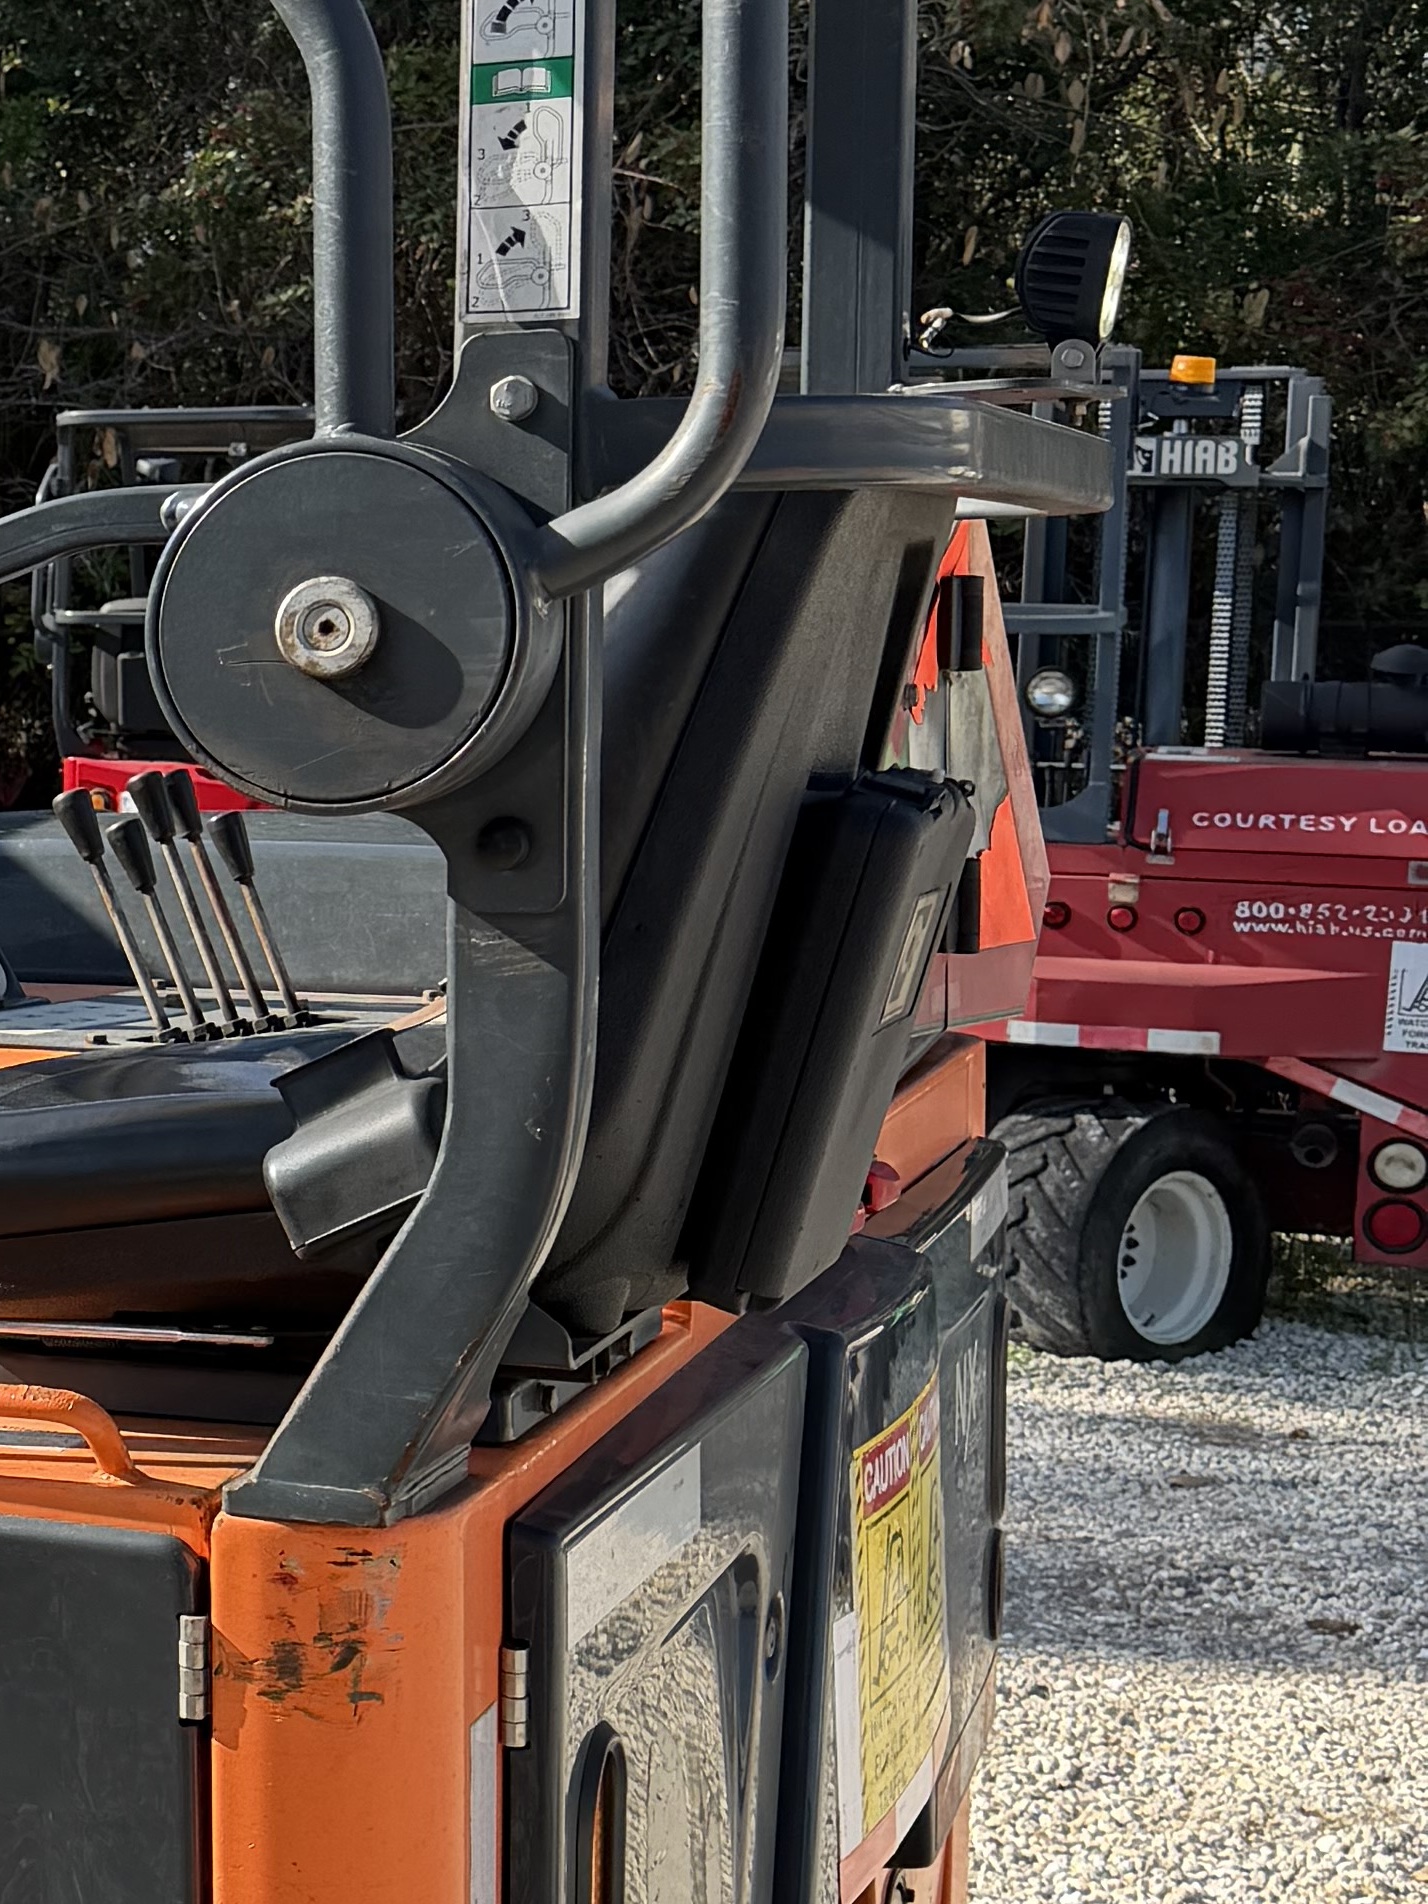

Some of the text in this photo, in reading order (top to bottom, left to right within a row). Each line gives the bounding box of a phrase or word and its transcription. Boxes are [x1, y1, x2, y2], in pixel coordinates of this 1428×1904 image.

[477, 148, 486, 161] 3
[522, 209, 531, 222] 3
[471, 296, 480, 308] 2
[1160, 440, 1239, 475] HIAB
[1192, 812, 1358, 833] COURTESY
[955, 1338, 979, 1463] NX
[863, 1431, 910, 1504] CAUTION
